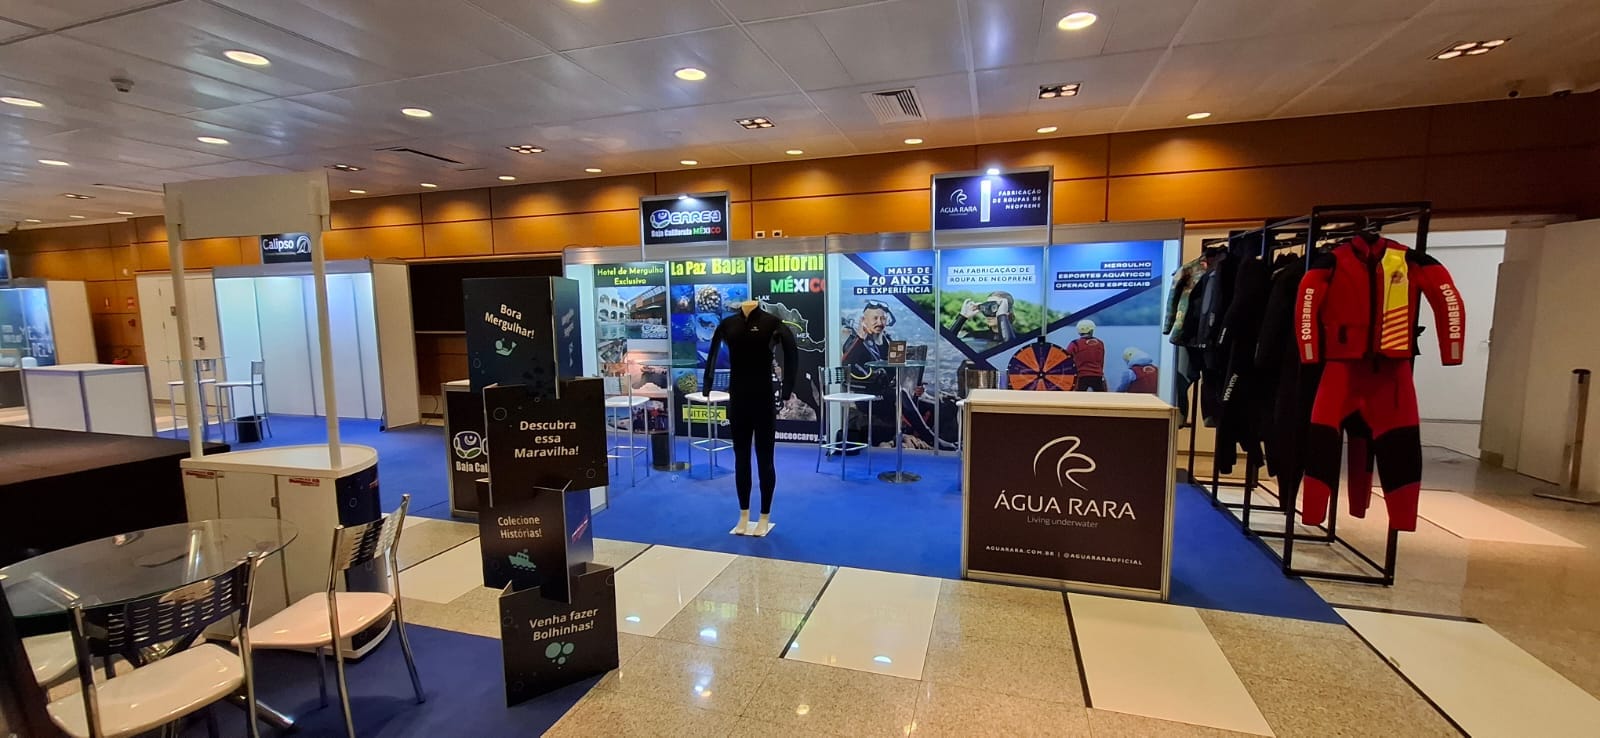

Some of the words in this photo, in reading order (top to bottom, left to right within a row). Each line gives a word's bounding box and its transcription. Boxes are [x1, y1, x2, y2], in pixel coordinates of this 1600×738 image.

[693, 226, 721, 235] MÉXICO
[262, 238, 294, 252] Calipso
[597, 267, 617, 276] Hotel
[617, 266, 628, 275] de
[629, 265, 664, 275] Mergulho
[671, 261, 683, 276] La
[685, 260, 707, 275] Paz
[711, 257, 746, 275] Baja
[888, 267, 913, 275] MAIS
[917, 266, 930, 274] DE
[614, 277, 646, 285] Exclusivo
[871, 276, 886, 286] 20
[890, 275, 930, 285] ANOS
[870, 285, 930, 294] EXPERIÊNCIA
[500, 303, 522, 321] Bora
[1301, 288, 1315, 340] BOMBEIROS
[1440, 283, 1460, 339] BOMBEIROS
[484, 311, 535, 339] Mergulhar!
[519, 419, 577, 431] Descubra
[534, 433, 561, 444] essa
[514, 446, 579, 459] Maravilha!
[455, 461, 474, 473] Baja
[993, 489, 1062, 514] ÁGUA
[1068, 498, 1136, 520] RARA
[497, 515, 541, 527] Colecione
[1026, 515, 1051, 526] Living
[1051, 518, 1099, 528] underwater
[500, 527, 543, 539] Histórias!
[1063, 552, 1143, 566] @AGUARARAOFICIAL
[529, 614, 567, 629] Venha
[569, 607, 600, 621] fazer
[533, 620, 595, 642] Bolhinhas!
